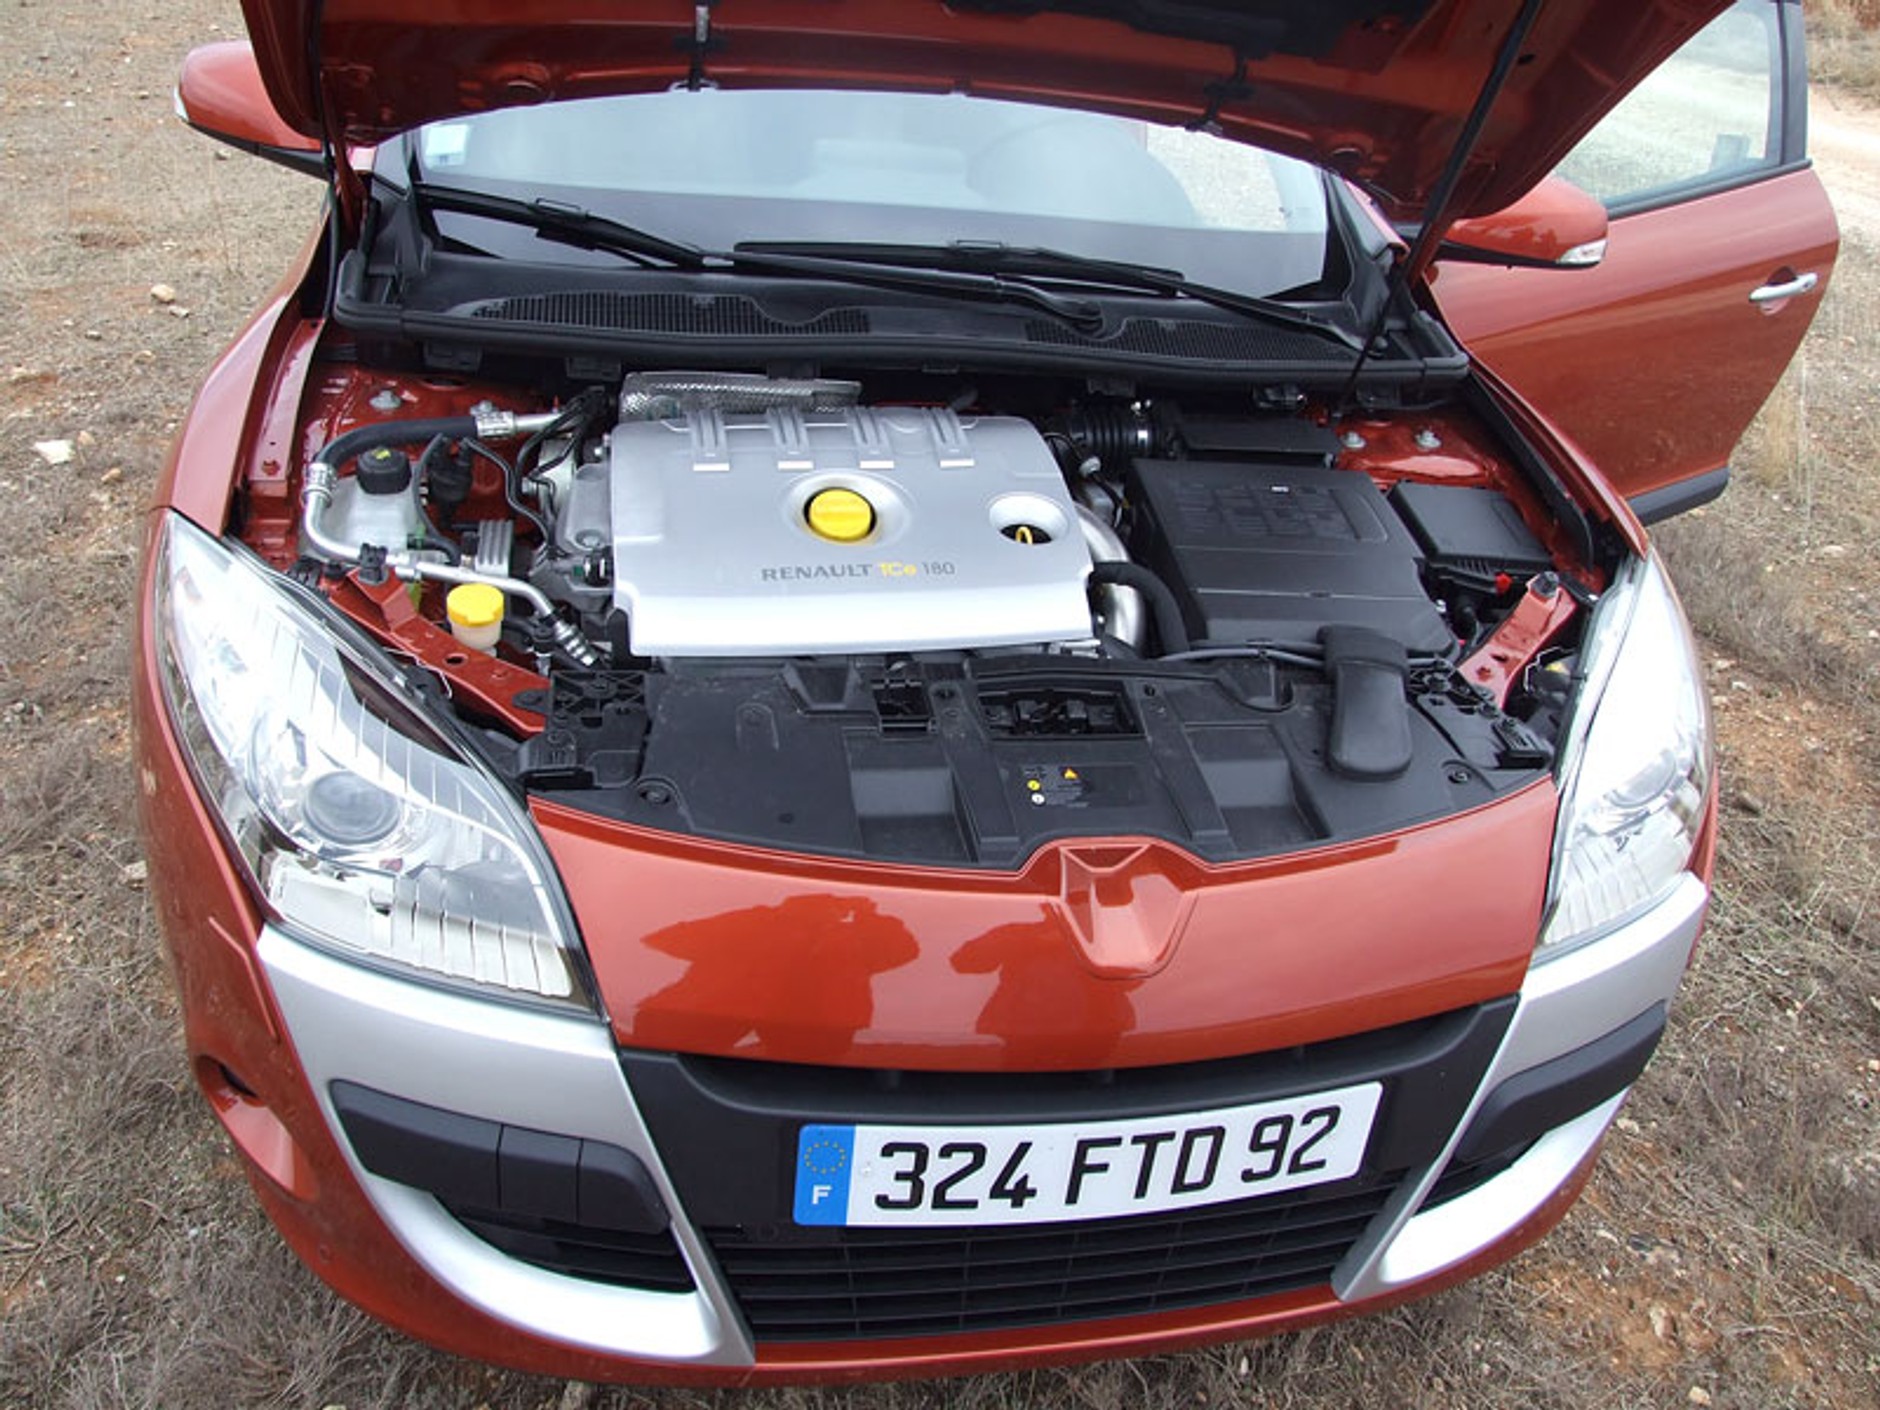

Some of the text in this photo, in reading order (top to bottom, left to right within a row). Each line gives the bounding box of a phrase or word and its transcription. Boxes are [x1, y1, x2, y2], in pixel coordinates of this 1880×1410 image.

[761, 562, 955, 581] RENAULT TCe 180
[874, 1105, 1342, 1210] 324 FTD 92
[812, 1185, 831, 1205] F
